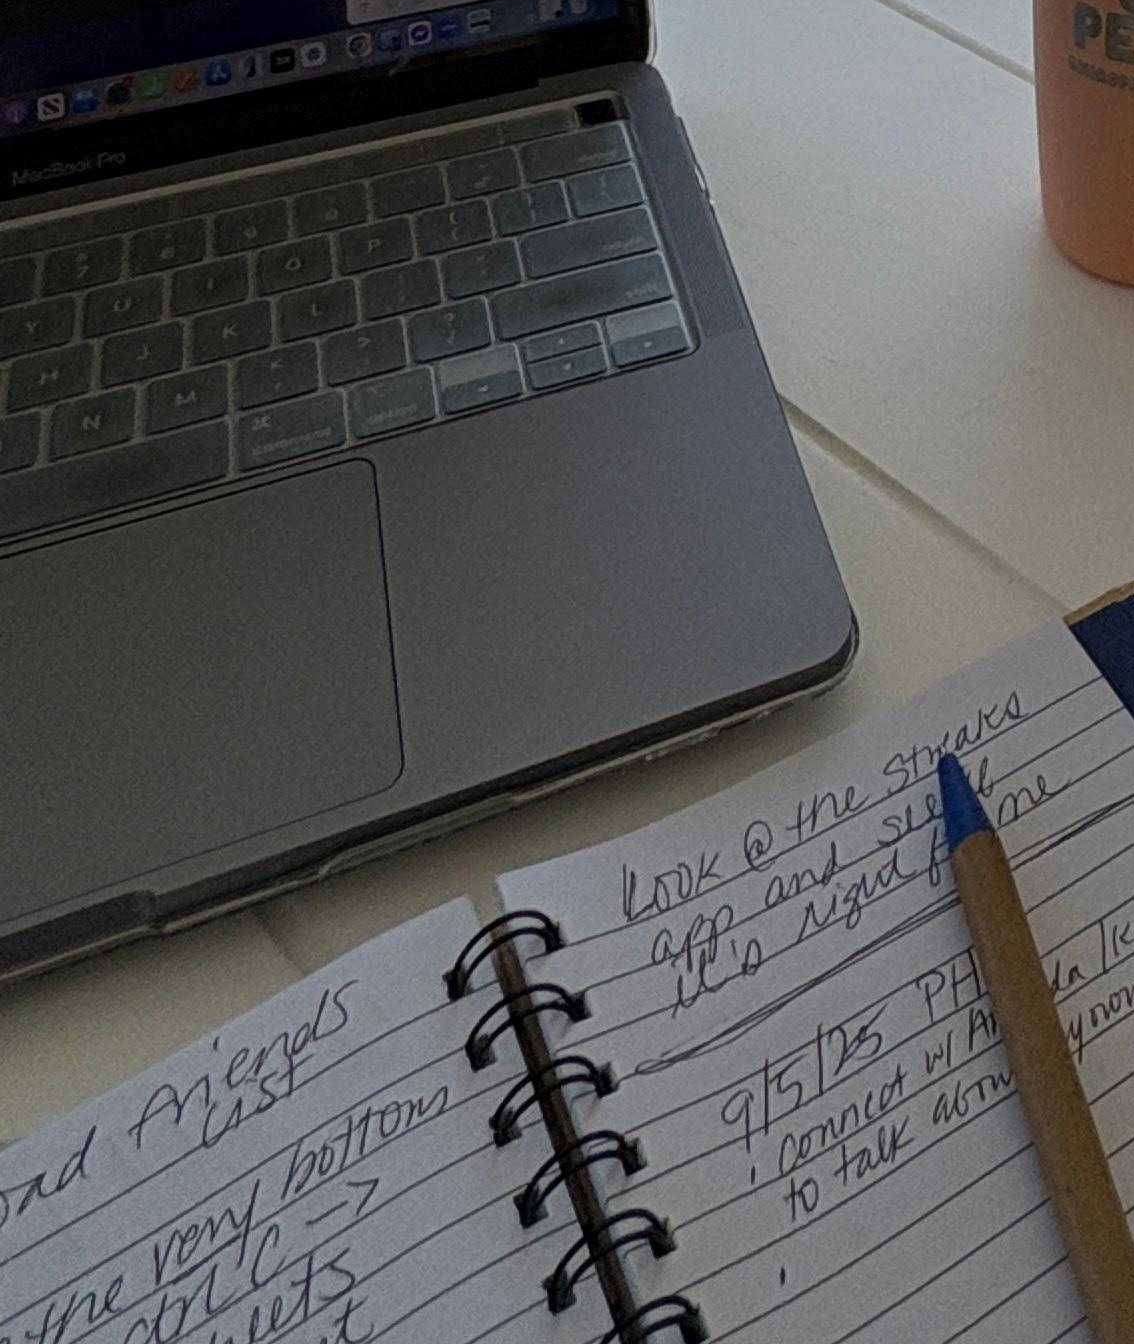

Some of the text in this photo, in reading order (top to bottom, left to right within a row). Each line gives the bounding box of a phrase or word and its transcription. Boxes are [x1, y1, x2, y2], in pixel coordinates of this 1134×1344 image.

[11, 151, 127, 188] MacBook Pro
[621, 848, 723, 924] Look
[741, 820, 776, 872] @
[785, 785, 873, 845] the
[998, 775, 1076, 830] me
[650, 905, 735, 973] app
[763, 841, 846, 912] and
[128, 978, 361, 1150] friends
[719, 1002, 892, 1152] 9/5/25
[153, 1177, 262, 1286] very
[279, 1085, 450, 1202] bottom
[780, 1175, 822, 1224] to
[833, 1123, 917, 1190] talk
[930, 1076, 1016, 1126] abou
